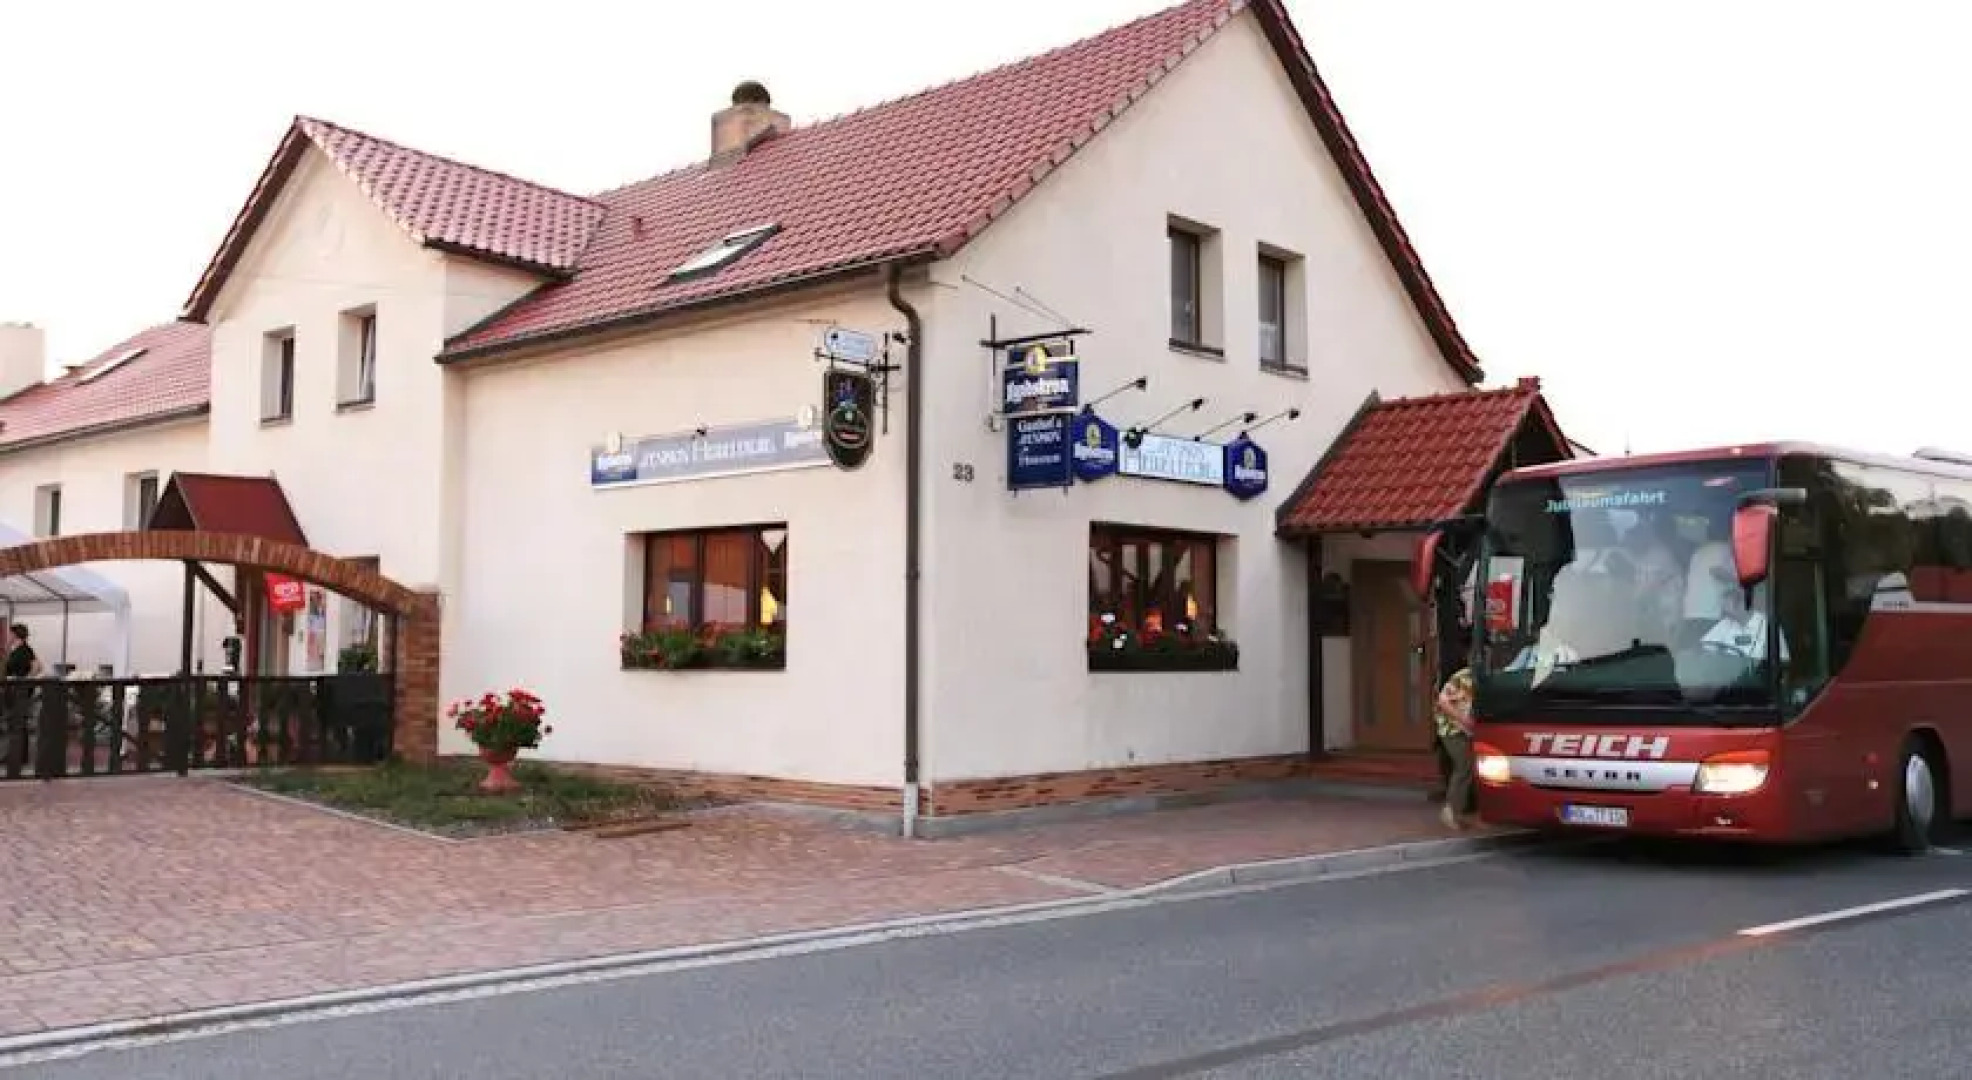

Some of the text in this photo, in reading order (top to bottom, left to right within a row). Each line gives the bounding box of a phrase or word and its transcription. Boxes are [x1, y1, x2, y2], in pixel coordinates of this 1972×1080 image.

[953, 464, 975, 482] 23
[1523, 731, 1670, 759] TEICH
[1543, 767, 1642, 781] SETRA
